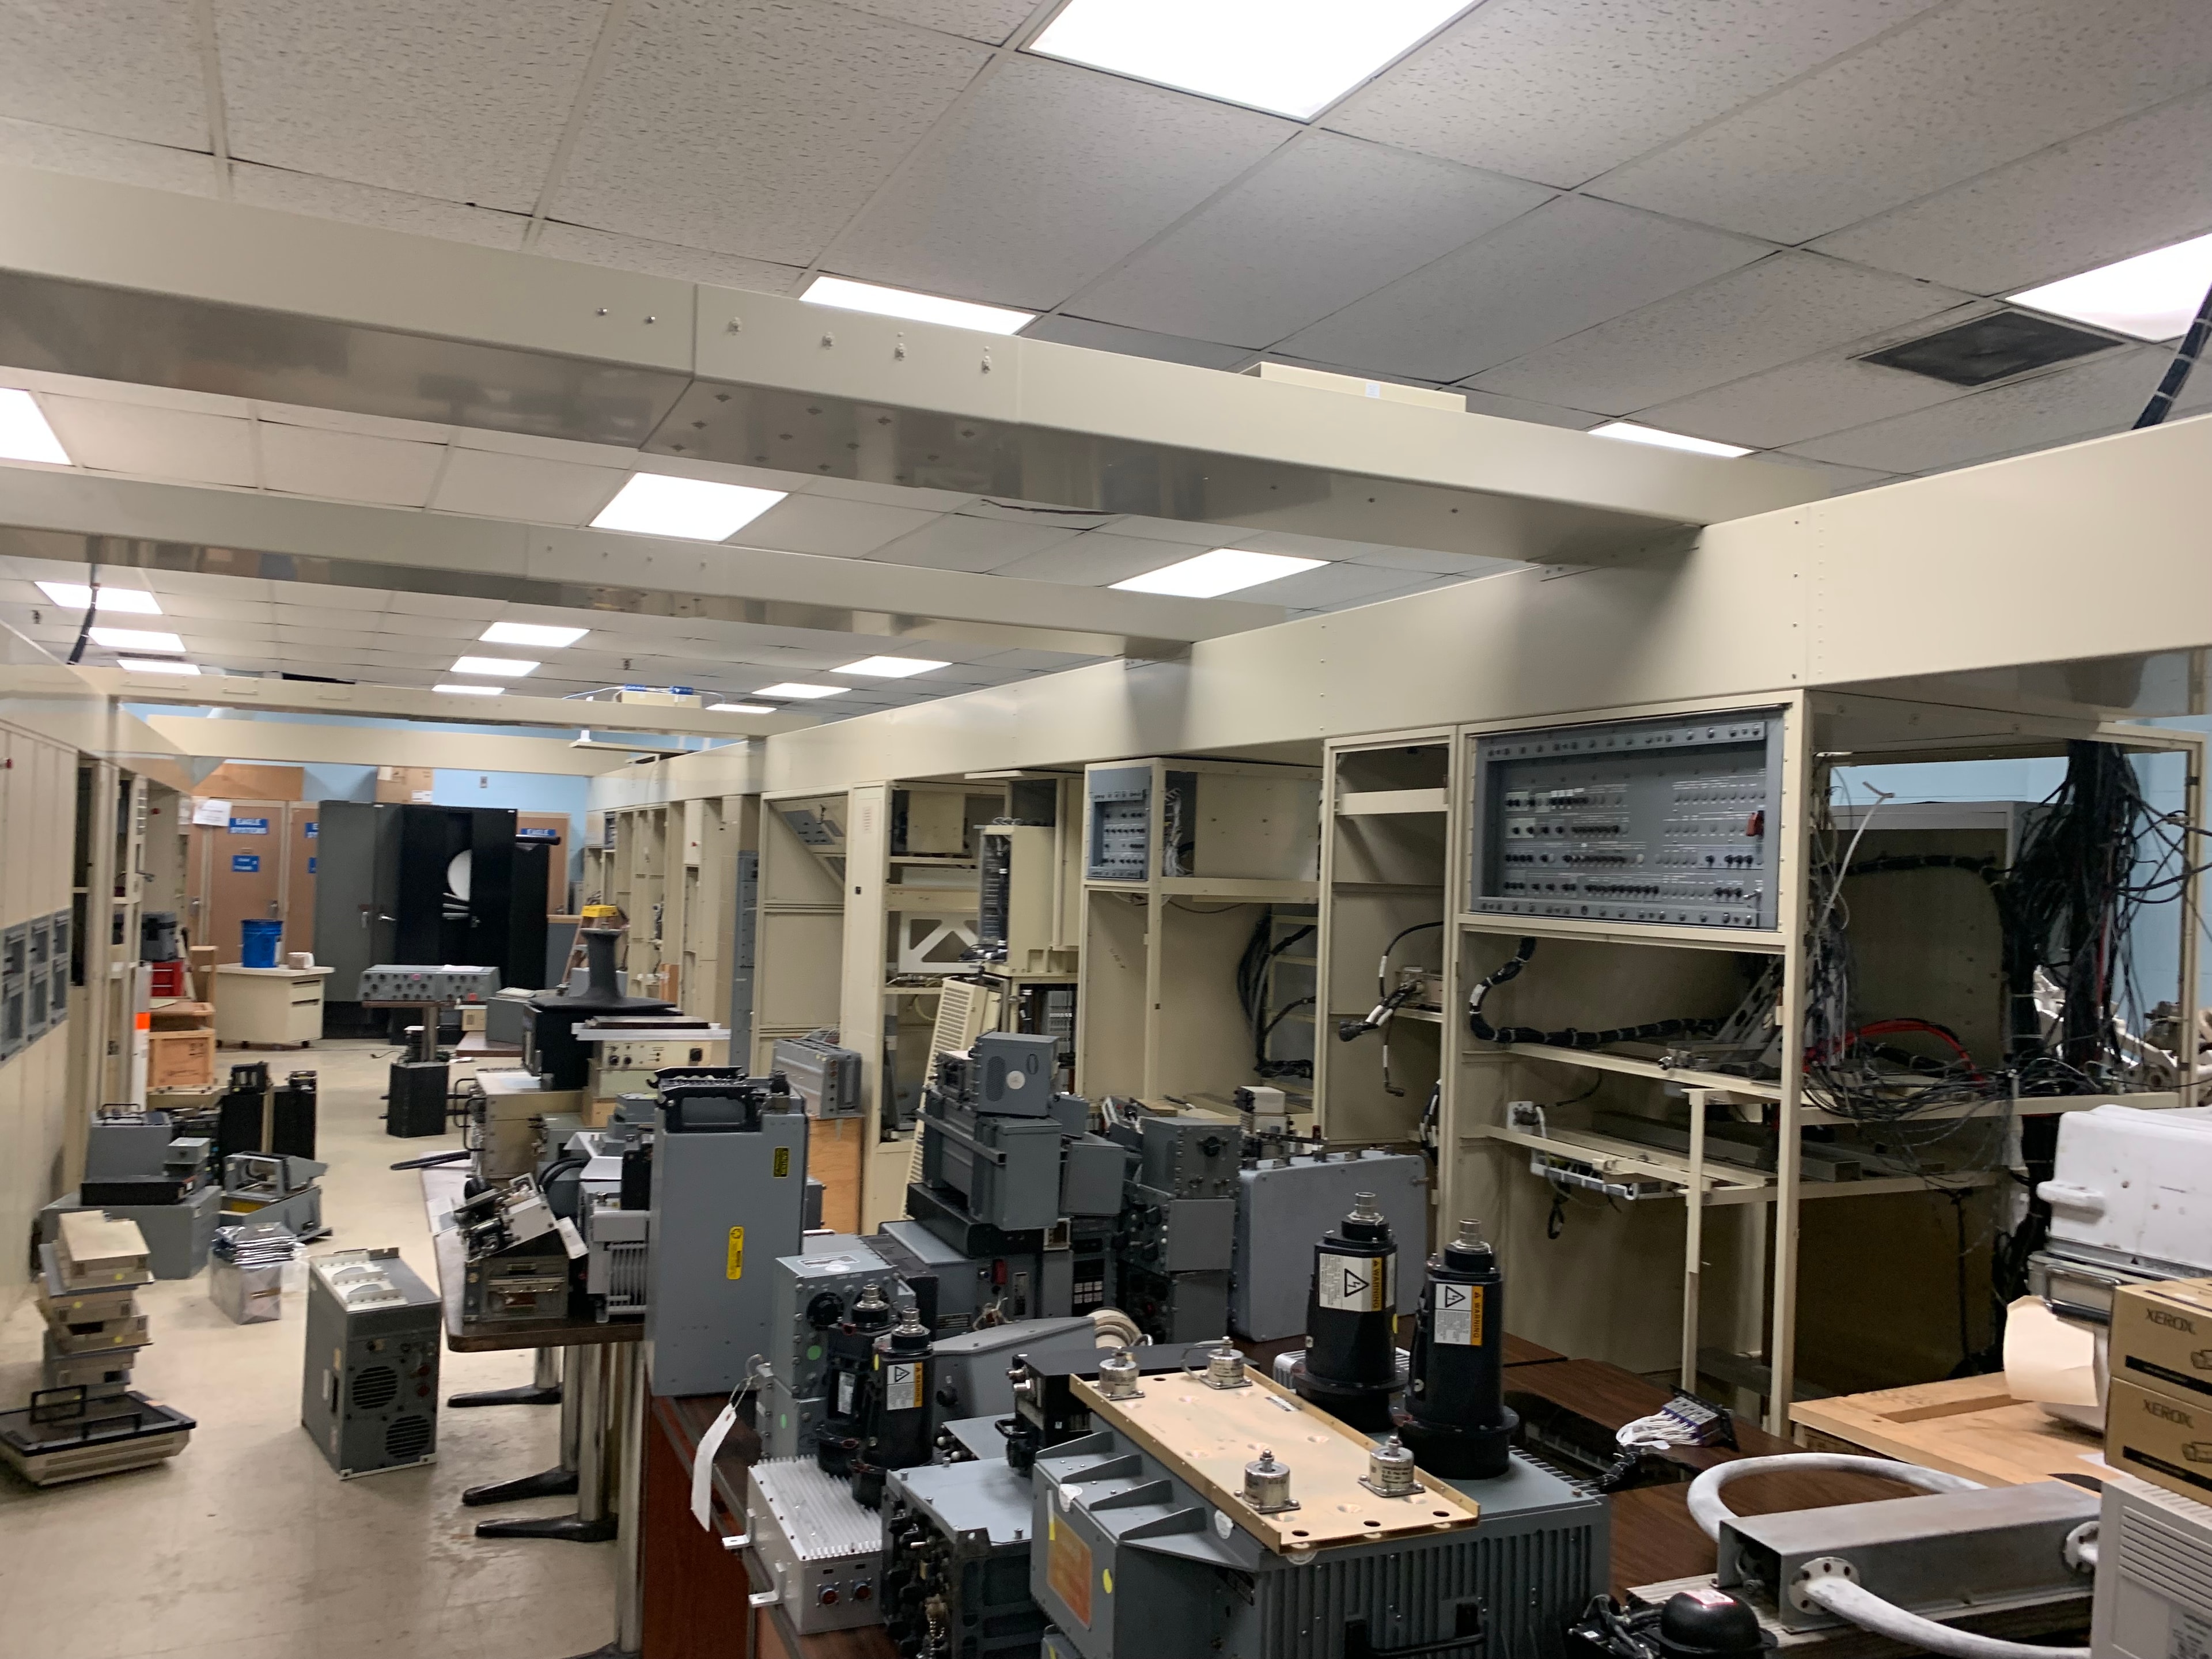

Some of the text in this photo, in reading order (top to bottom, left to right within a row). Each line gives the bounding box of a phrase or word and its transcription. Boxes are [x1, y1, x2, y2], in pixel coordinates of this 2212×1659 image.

[1473, 1302, 1481, 1338] WARNING
[2146, 1308, 2196, 1335] XEROX
[2143, 1399, 2194, 1429] XEROX
